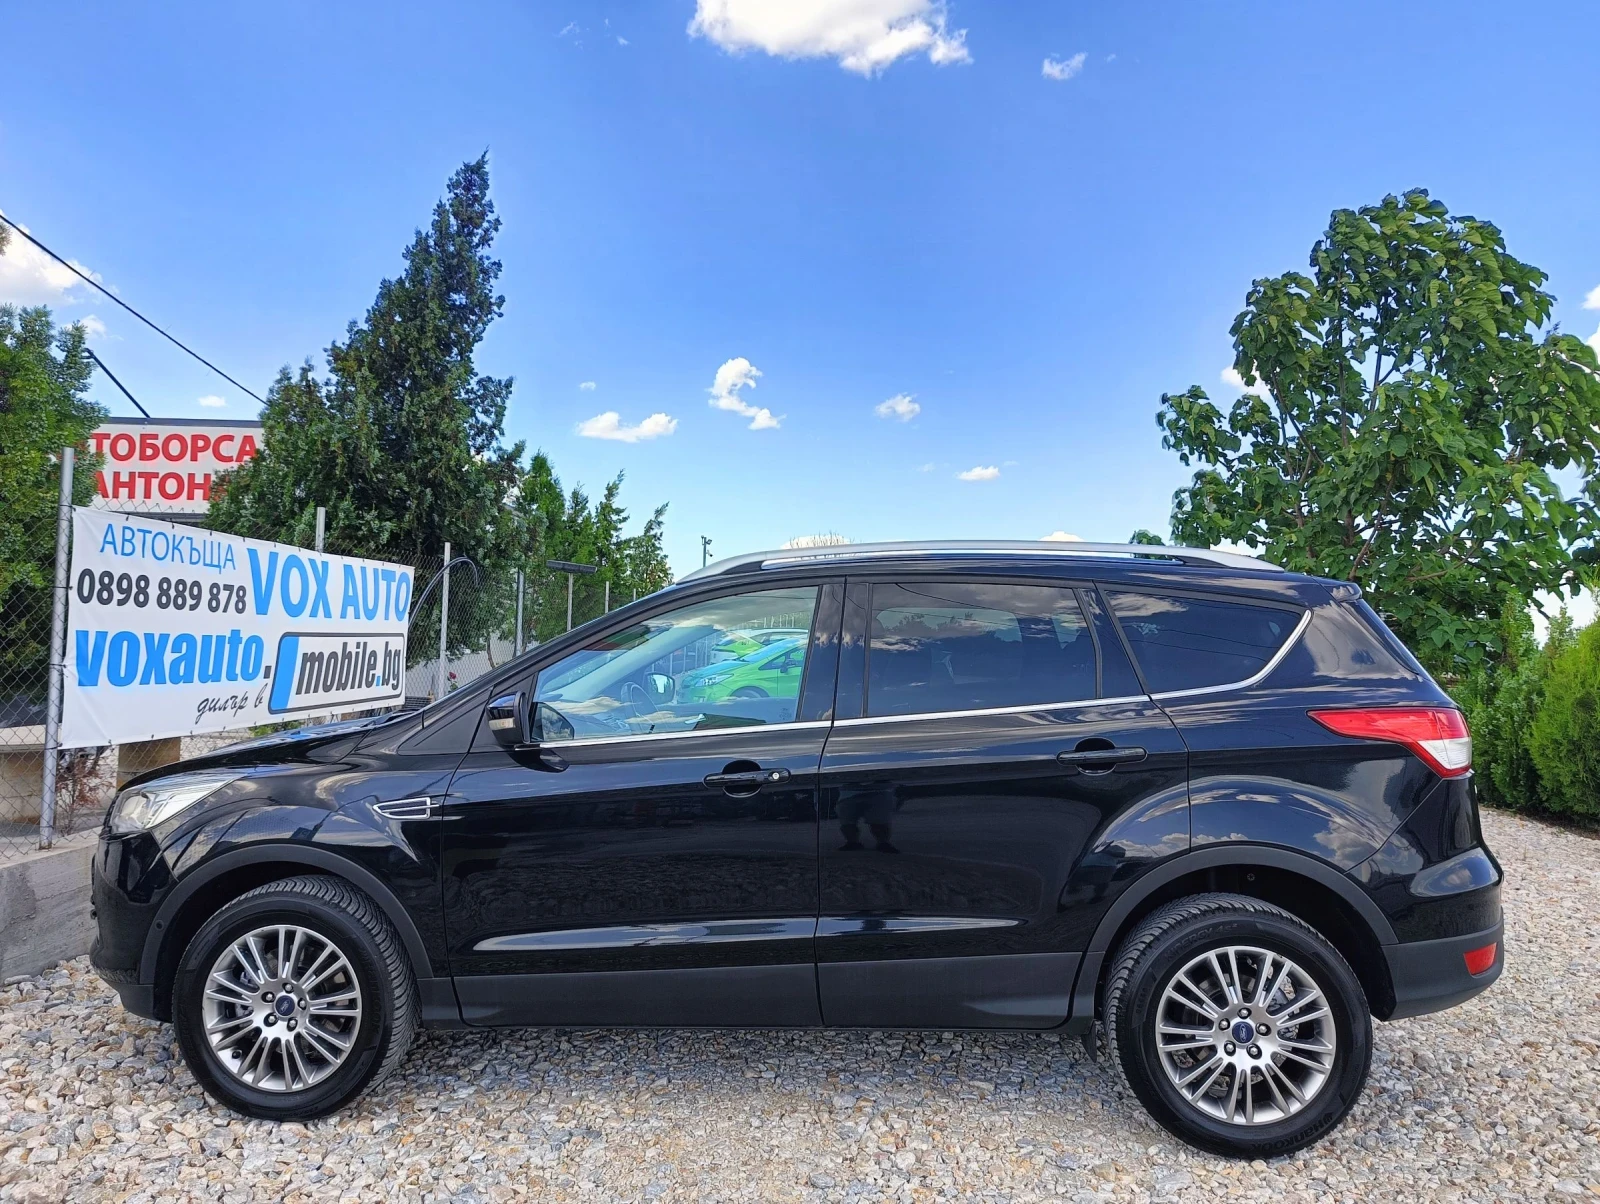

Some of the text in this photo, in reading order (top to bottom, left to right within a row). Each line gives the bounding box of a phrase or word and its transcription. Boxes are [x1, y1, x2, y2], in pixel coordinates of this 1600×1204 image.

[90, 432, 258, 463] ТОБОРСА
[92, 470, 229, 501] АНТОН
[100, 523, 236, 575] АВТОКЪЩА
[76, 568, 247, 614] 0898 889 878
[247, 547, 411, 622] VOX AUTO
[296, 641, 402, 695] mobile.bg
